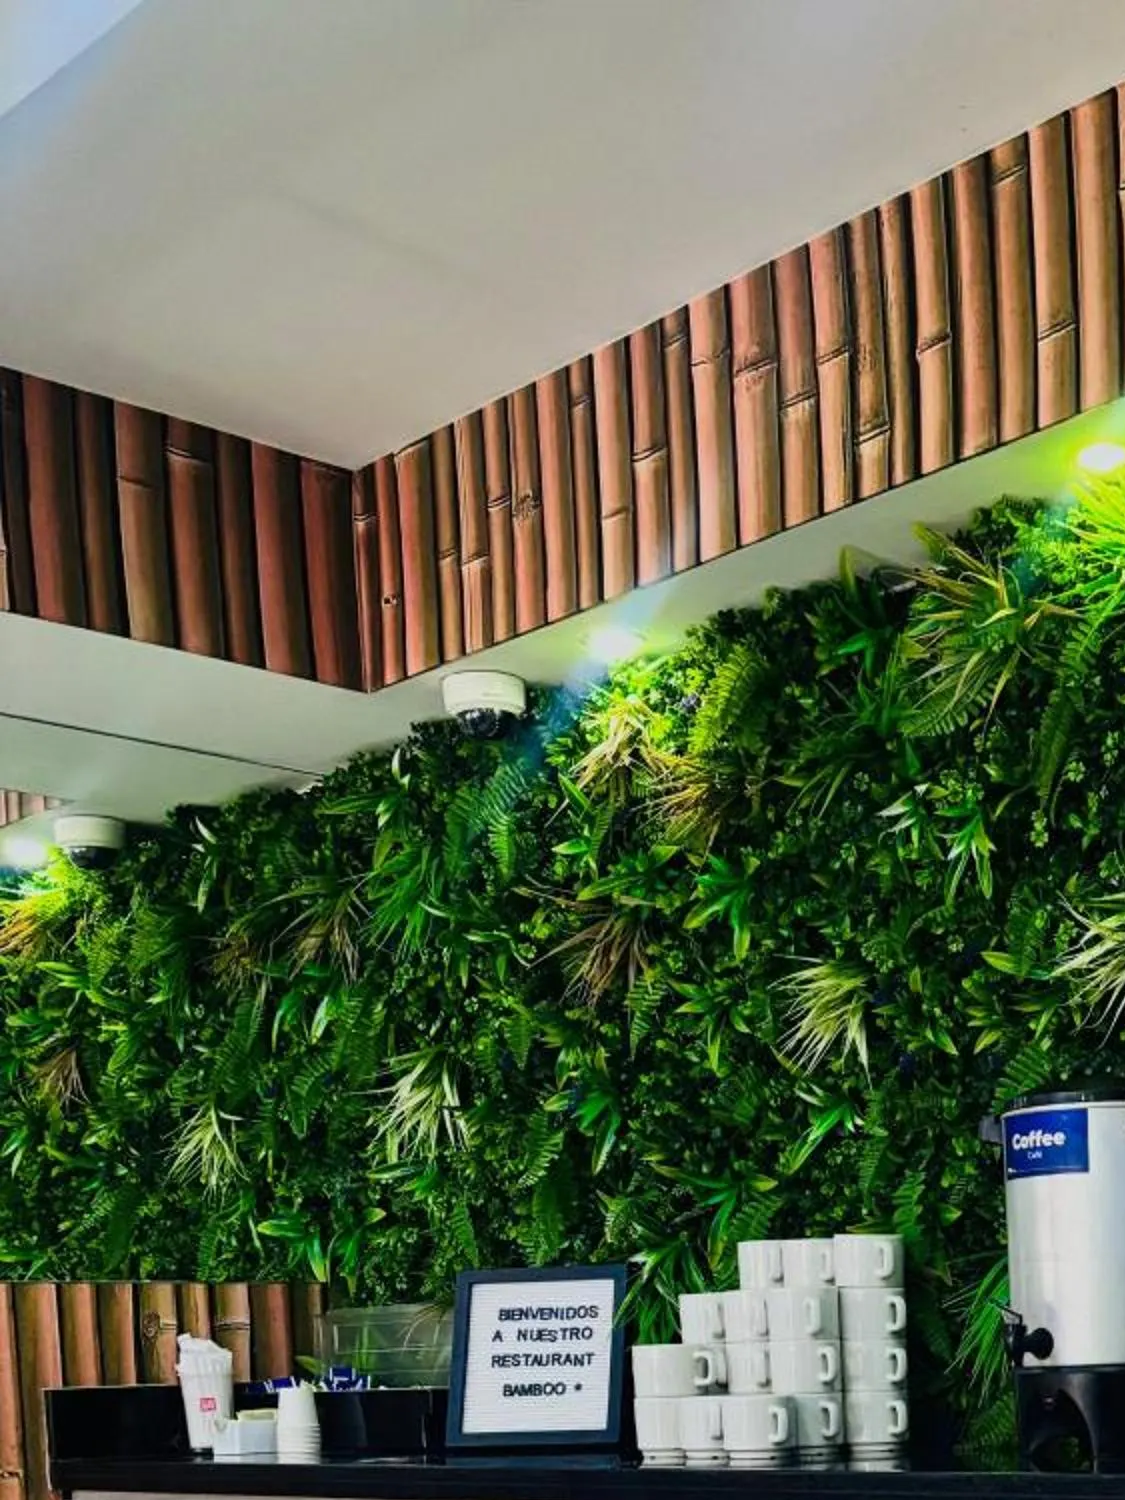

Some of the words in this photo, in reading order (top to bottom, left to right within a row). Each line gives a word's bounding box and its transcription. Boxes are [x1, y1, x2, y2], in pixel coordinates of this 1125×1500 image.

[1012, 1129, 1066, 1151] Coffee
[498, 1305, 599, 1322] BIENVENIDOS
[491, 1329, 503, 1342] A
[516, 1326, 593, 1343] NUESTRO
[491, 1352, 596, 1369] RESTAURANT
[502, 1382, 567, 1397] BAMBOO
